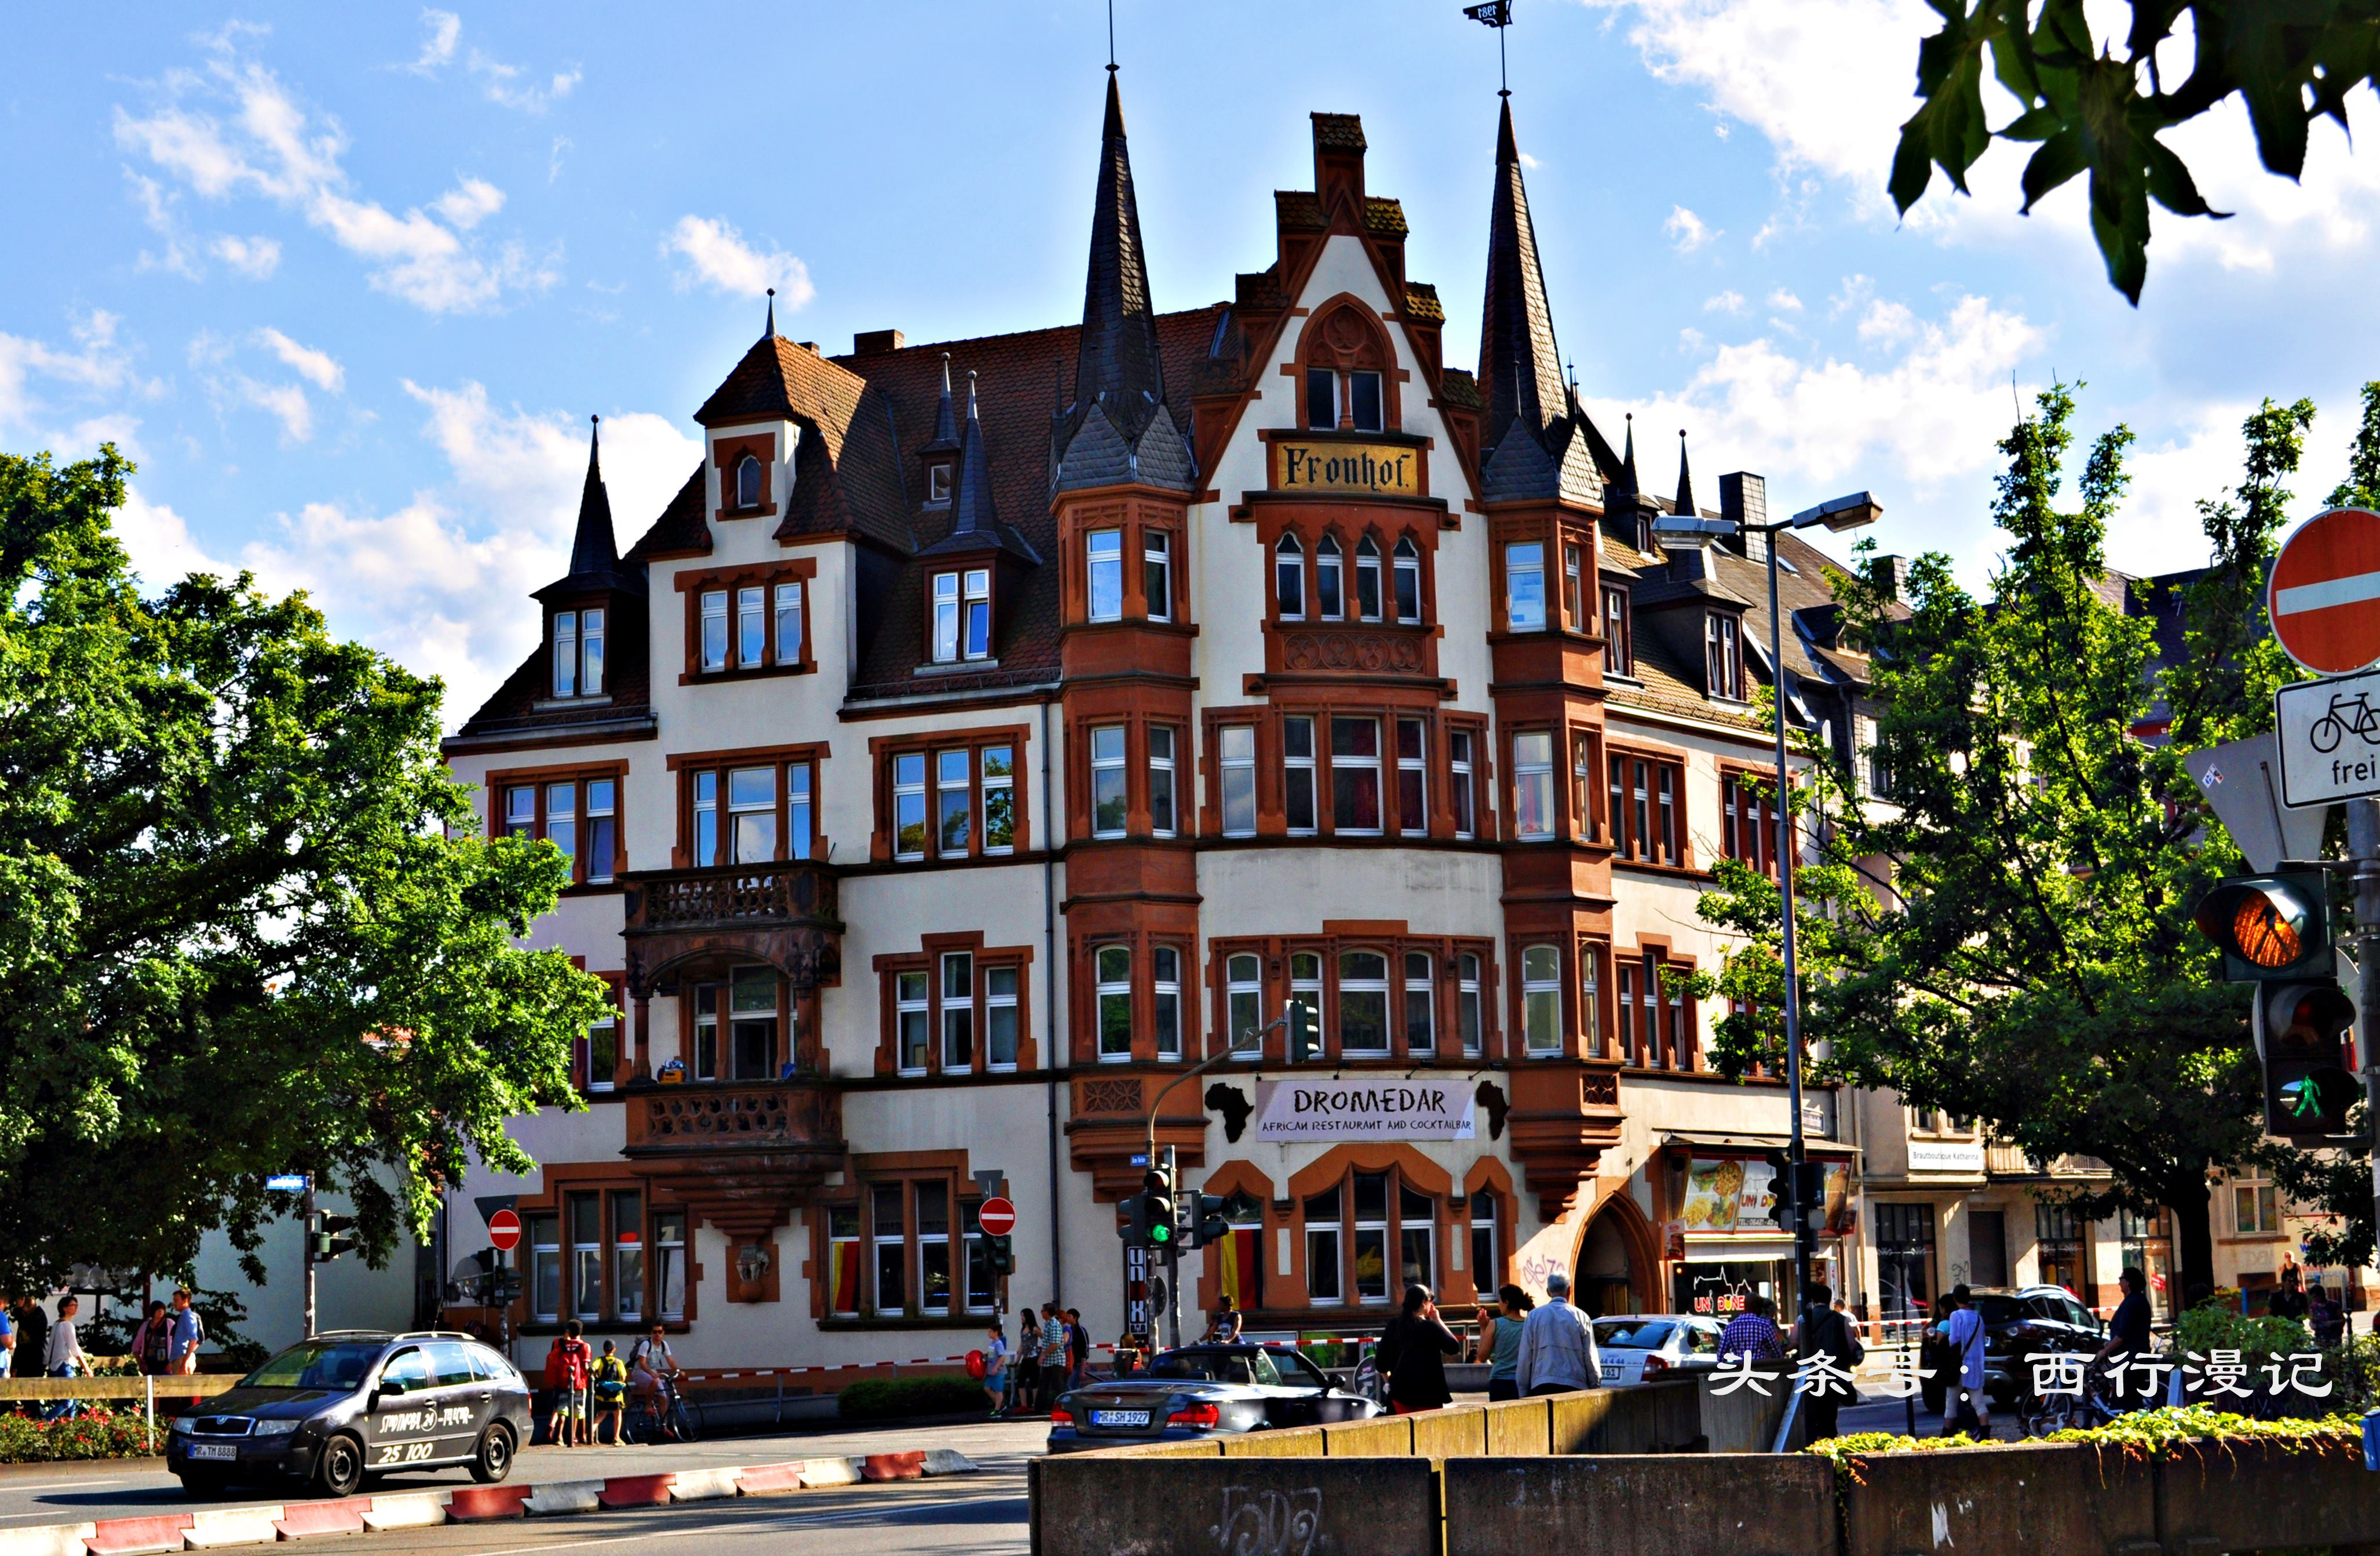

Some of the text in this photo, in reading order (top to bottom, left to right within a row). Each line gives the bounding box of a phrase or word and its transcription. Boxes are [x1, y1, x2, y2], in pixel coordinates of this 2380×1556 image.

[2331, 754, 2376, 785] frei
[1294, 1088, 1446, 1114] DROMEDAR
[1262, 1119, 1471, 1131] AFRICAN RESTAURANT AND COCKTAILBAR
[1913, 1151, 1951, 1161] Brautboutique
[1115, 1412, 1126, 1422] SH
[1127, 1412, 1148, 1422] 1927
[217, 1447, 235, 1457] 8888
[378, 1442, 433, 1464] 25 100
